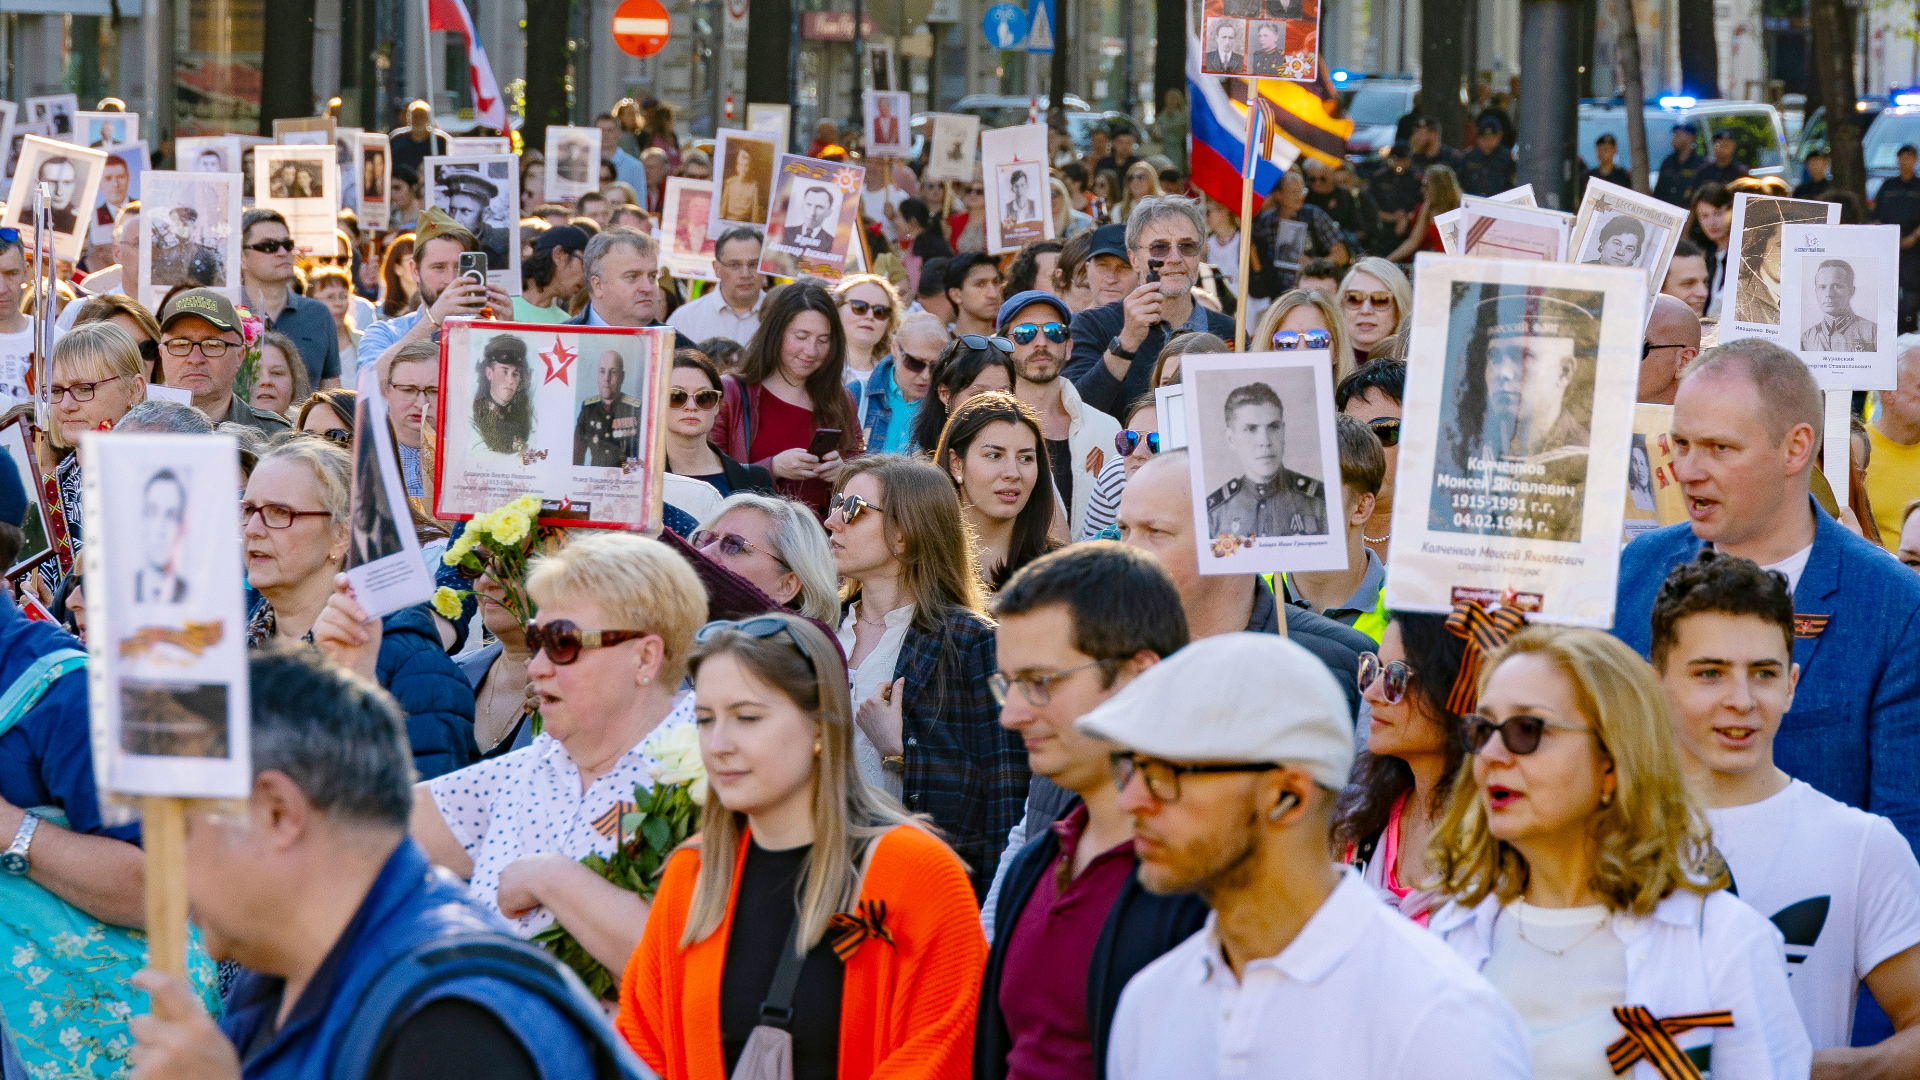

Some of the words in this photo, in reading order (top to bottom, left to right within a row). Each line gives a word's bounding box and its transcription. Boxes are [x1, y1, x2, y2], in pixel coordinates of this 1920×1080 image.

[175, 295, 218, 313] VIENNA
[1467, 457, 1546, 475] Колченков
[1437, 473, 1490, 490] Моисей
[1490, 475, 1576, 498] Яковлевич
[1451, 493, 1527, 513] 1915-1991
[1530, 501, 1556, 516] г.г.
[1453, 512, 1534, 531] 04.02.1944
[1523, 550, 1586, 567] Яковлевич
